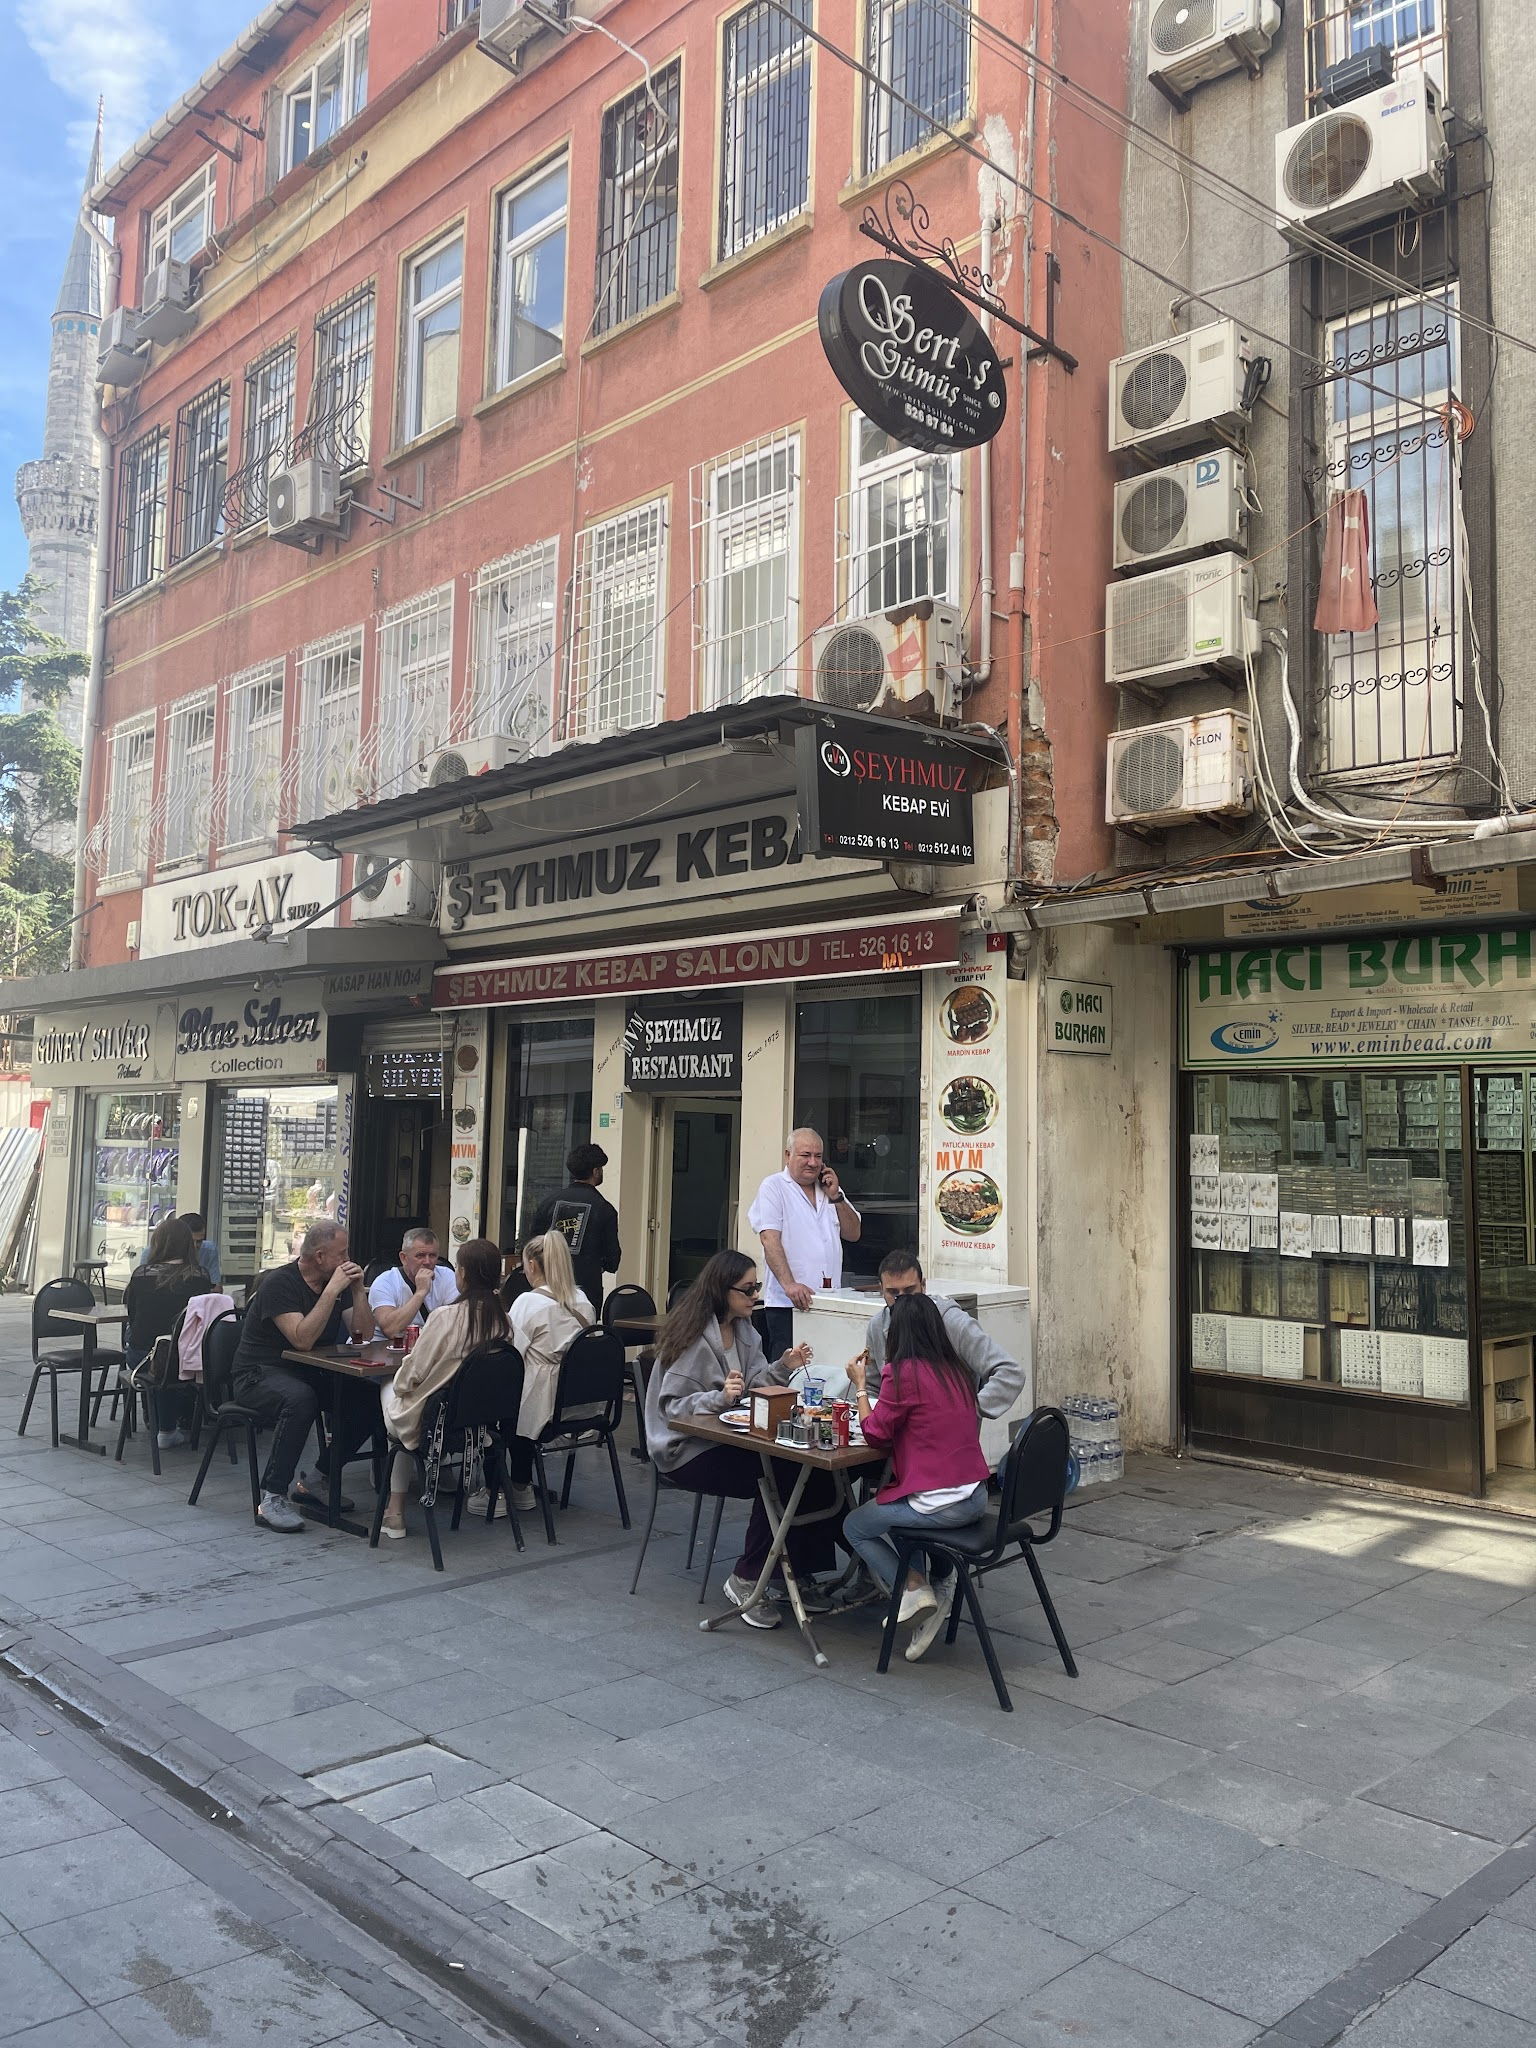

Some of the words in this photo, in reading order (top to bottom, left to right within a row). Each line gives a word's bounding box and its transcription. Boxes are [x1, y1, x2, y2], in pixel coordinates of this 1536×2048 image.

[1382, 99, 1415, 117] BEKO
[861, 340, 960, 407] Gümüş
[905, 403, 924, 422] 526
[963, 394, 982, 409] SINCE
[1190, 732, 1222, 747] KELON
[852, 749, 967, 792] ŞEYHMUZ
[882, 794, 927, 815] KEBAP
[930, 799, 950, 818] EVİ
[839, 835, 856, 846] 0212
[857, 834, 873, 847] 526
[876, 836, 886, 849] 16
[889, 838, 899, 850] 13
[918, 843, 933, 853] 0212
[934, 842, 949, 855] 512
[951, 844, 960, 856] 41
[962, 845, 972, 857] 02
[447, 838, 661, 931] ŞEYHMUZ
[172, 873, 293, 941] TOK-AY
[287, 901, 320, 921] SILVER
[449, 966, 568, 1006] ŞEYHMUZ
[575, 954, 668, 988] KEBAP
[676, 939, 810, 979] SALONU
[821, 940, 855, 961] TEL.
[859, 936, 886, 957] 526
[891, 933, 910, 954] 16
[915, 930, 934, 951] 13
[946, 965, 993, 977] ŞEYHMUZ
[954, 974, 974, 983] KEBAP
[975, 973, 986, 981] EVİ
[1200, 943, 1322, 1003] HACI
[328, 975, 365, 995] KASAP
[367, 970, 391, 990] HAN
[394, 966, 422, 986] NO:4
[1076, 993, 1103, 1014] HACI
[1330, 1007, 1356, 1020] Export
[1357, 1006, 1364, 1016] &
[1366, 1006, 1392, 1018] Import
[1399, 1003, 1439, 1016] Wholesale
[1440, 1003, 1447, 1013] &
[1450, 1001, 1473, 1013] Retail
[177, 1006, 240, 1055] Blue
[242, 997, 322, 1047] Silver
[645, 1016, 723, 1052] ŞEYHMUZ
[1055, 1021, 1106, 1044] BURHAN
[1325, 1021, 1349, 1033] BEAD
[1357, 1019, 1398, 1032] JEWELRY
[1407, 1018, 1436, 1030] CHAIN
[1449, 1016, 1481, 1028] TASSEL
[37, 1022, 90, 1064] GÜNEY
[91, 1019, 150, 1062] SILVER
[1311, 1033, 1492, 1054] www.eminbead.com
[211, 1057, 283, 1074] Collection
[631, 1054, 734, 1080] RESTAURANT
[451, 1144, 476, 1159] MVM
[941, 1240, 973, 1249] ŞEYHMUZ
[974, 1242, 995, 1251] KEBAP
